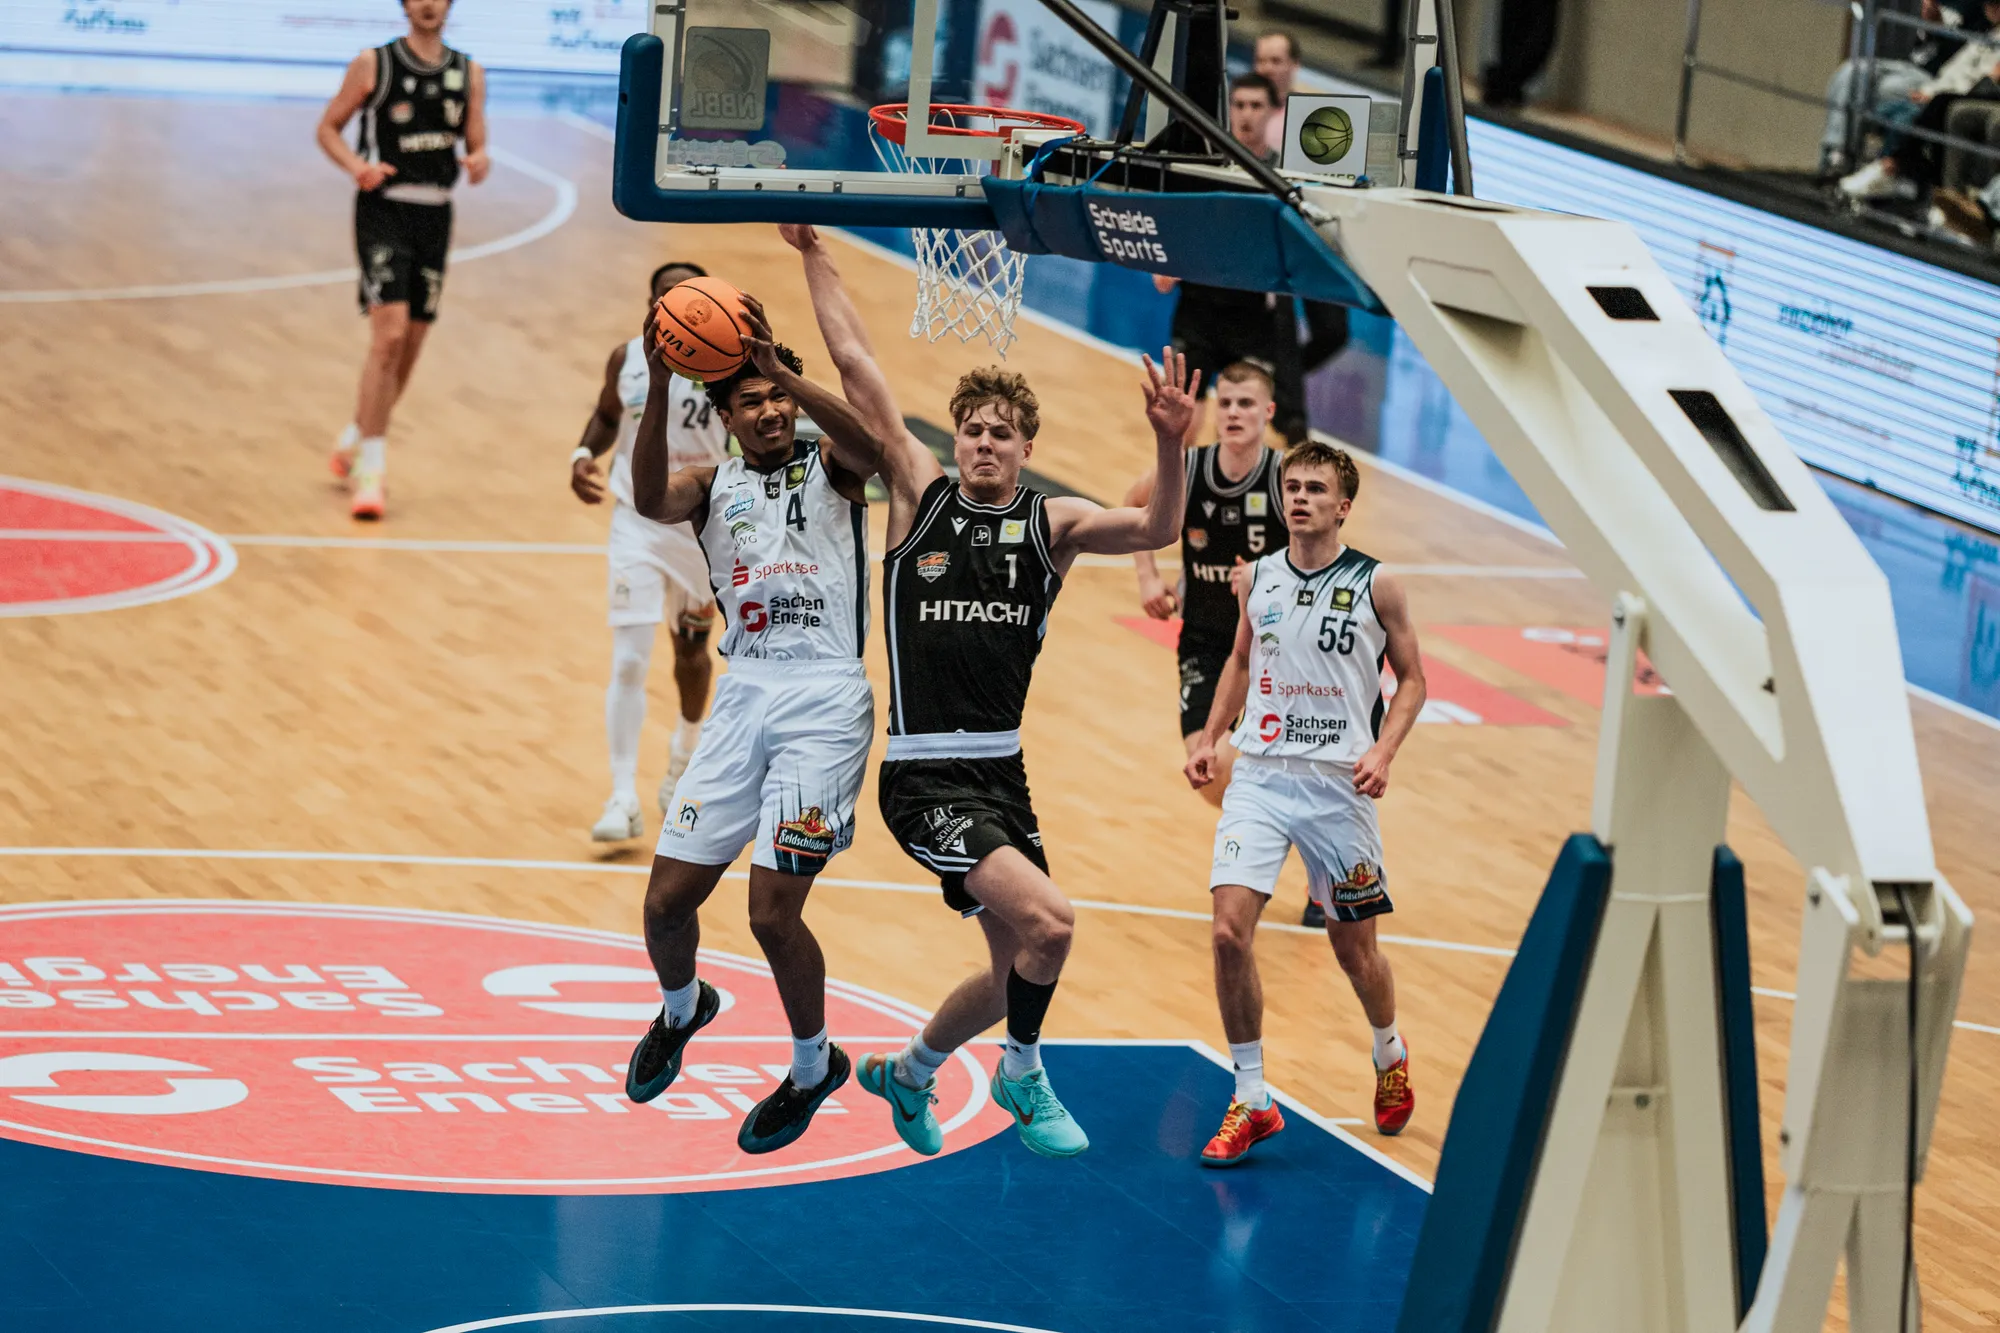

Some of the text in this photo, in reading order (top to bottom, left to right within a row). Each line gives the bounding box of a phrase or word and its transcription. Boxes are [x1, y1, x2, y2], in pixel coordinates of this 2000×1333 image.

[1088, 203, 1158, 235] Schelde
[1098, 230, 1168, 262] Sports
[682, 398, 711, 430] 24
[786, 492, 806, 531] 4
[1247, 524, 1266, 553] 5
[1005, 554, 1017, 588] 1
[919, 600, 1031, 626] HITACHI
[1318, 616, 1358, 655] 55
[1277, 681, 1345, 698] Sparkasse
[1286, 714, 1347, 729] Sachsen
[1286, 730, 1341, 746] Energie
